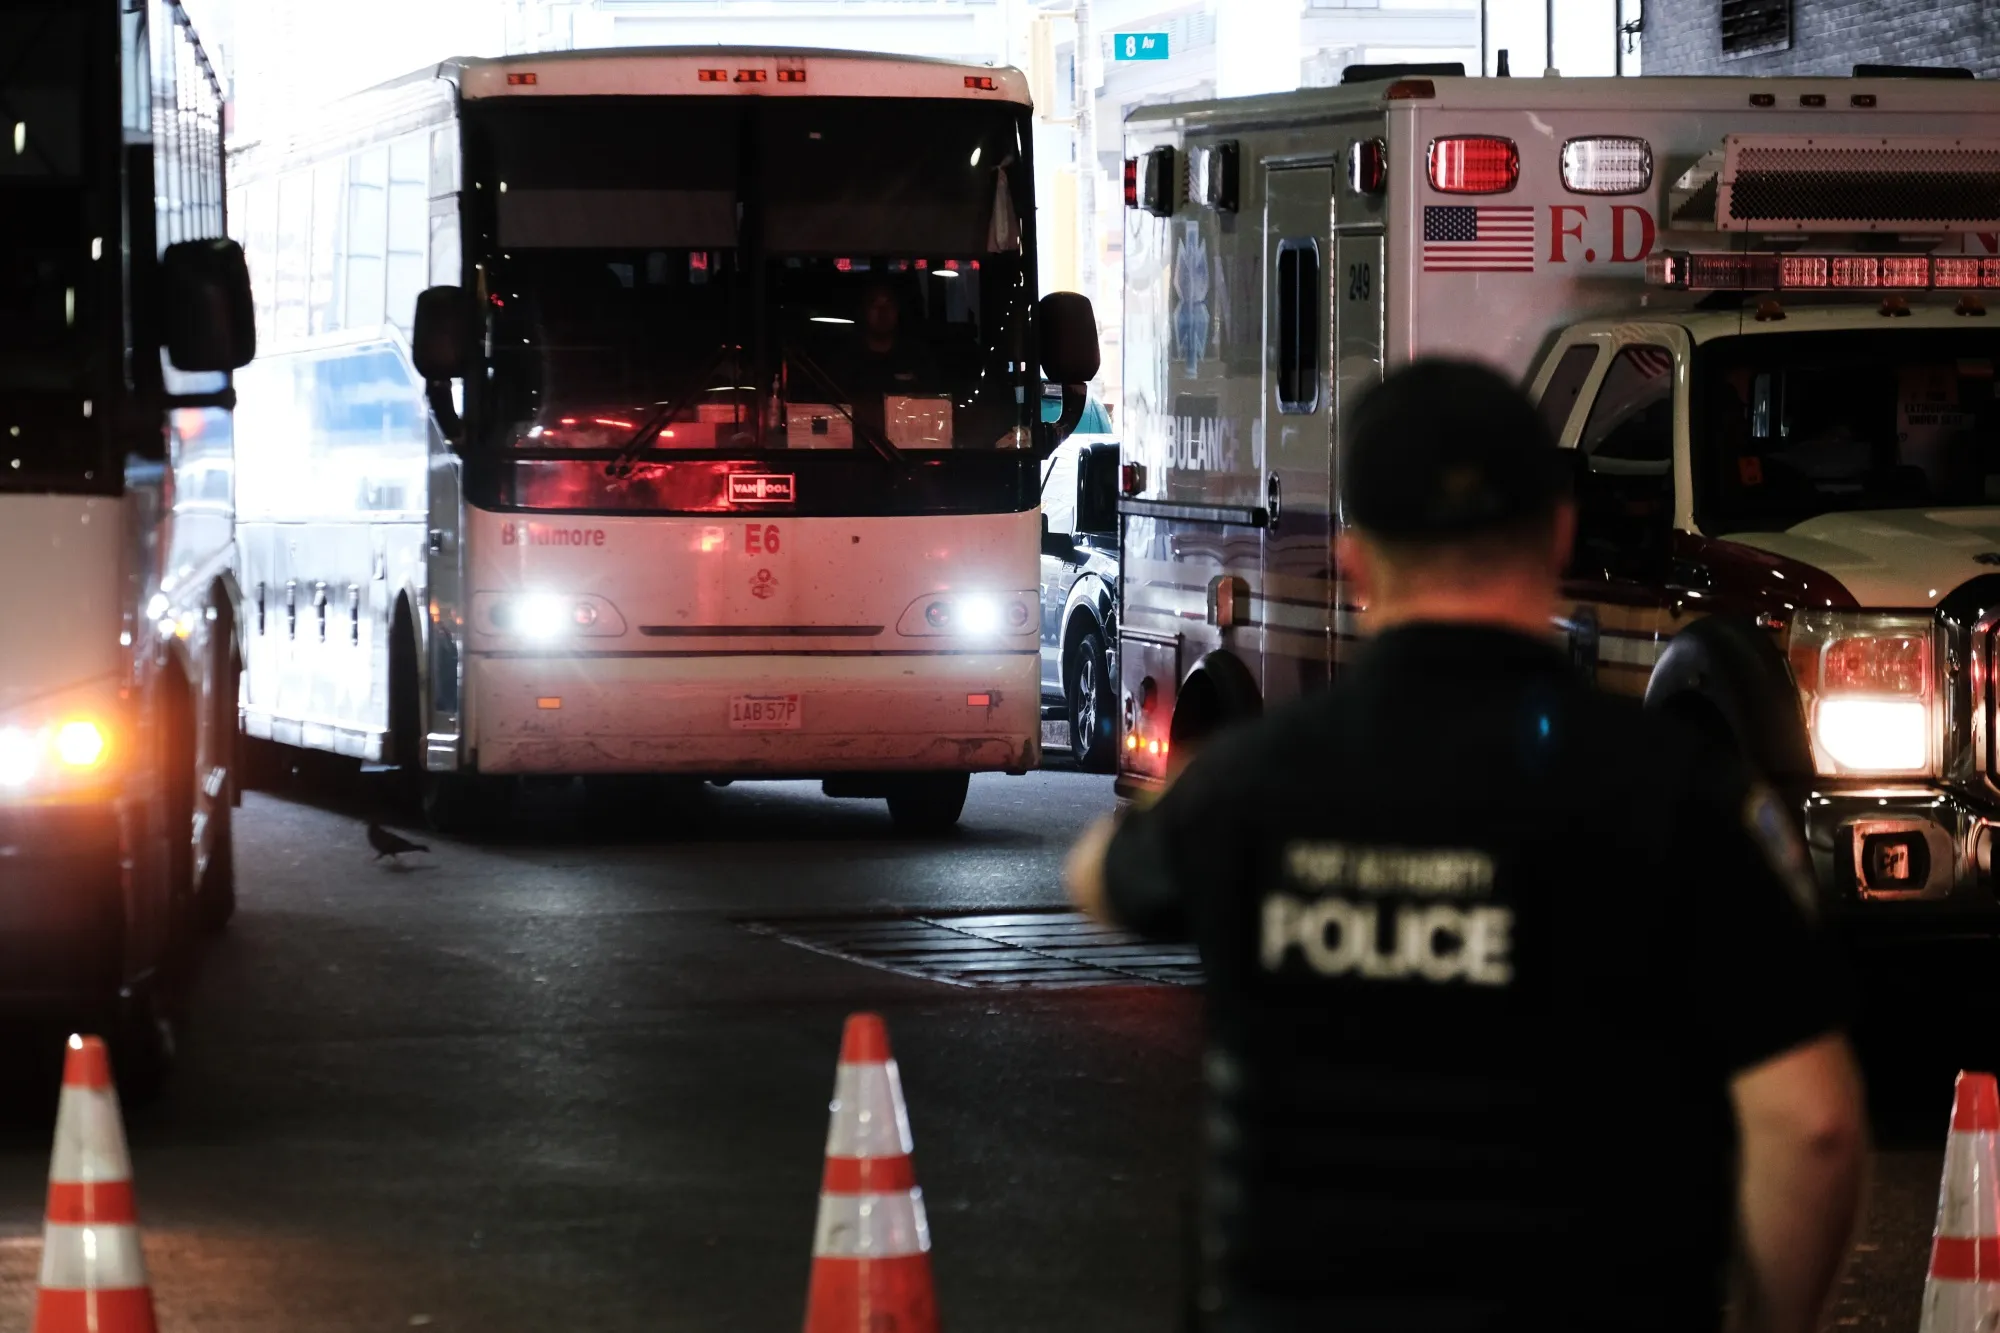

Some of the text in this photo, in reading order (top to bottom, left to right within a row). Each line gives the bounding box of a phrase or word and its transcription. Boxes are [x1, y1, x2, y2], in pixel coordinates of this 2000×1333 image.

[1125, 35, 1156, 58] 8 Av
[1349, 262, 1371, 302] 249
[1146, 414, 1240, 471] BULANCE
[501, 522, 606, 547] Btimore
[745, 523, 781, 554] E6
[1260, 894, 1515, 984] POLICE
